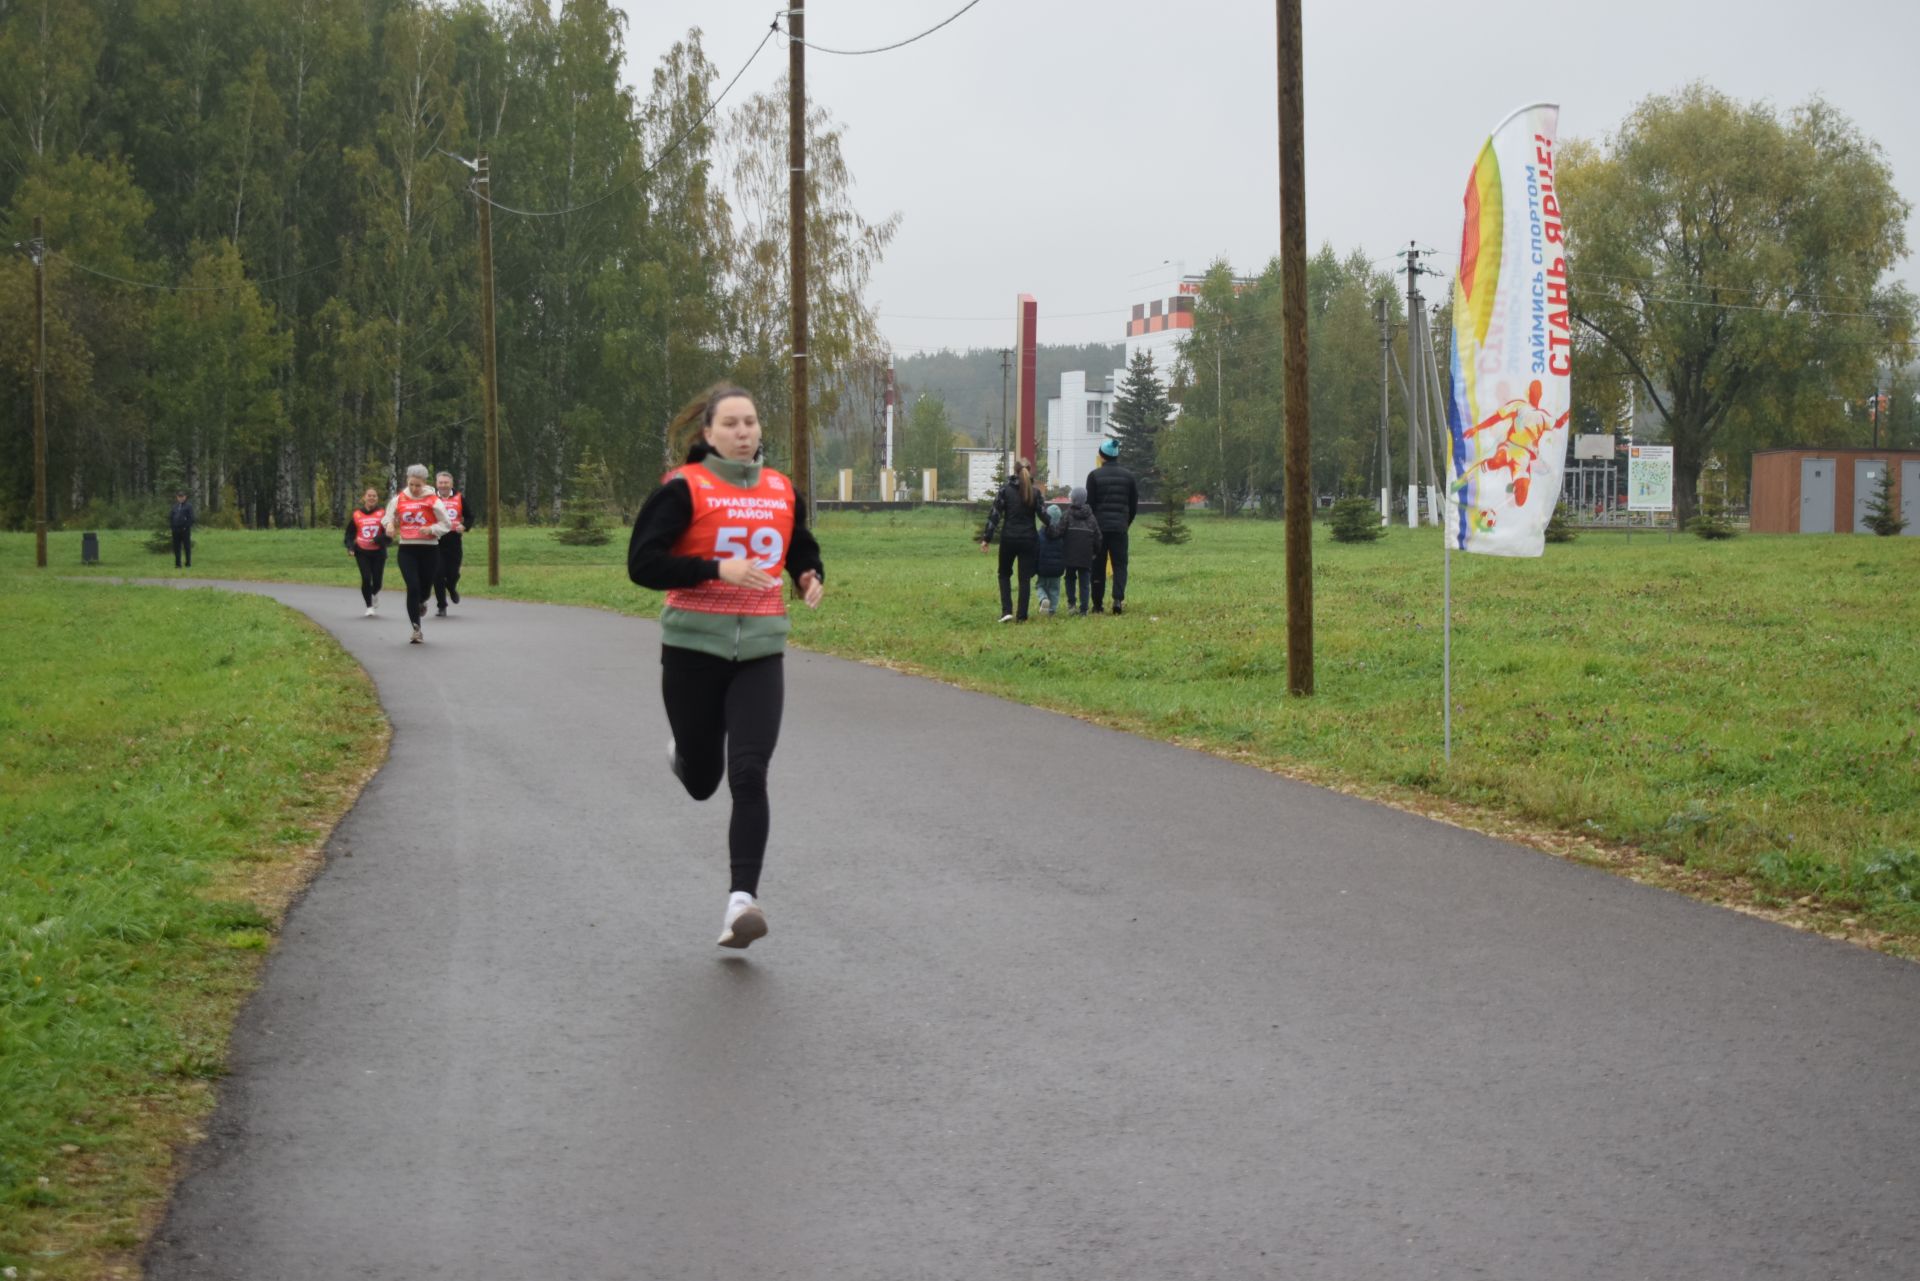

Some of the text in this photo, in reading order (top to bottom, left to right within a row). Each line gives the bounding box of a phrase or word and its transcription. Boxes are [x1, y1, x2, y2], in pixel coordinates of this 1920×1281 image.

[1525, 165, 1545, 374] ЗАЙМИСЬ СПОРТОМ
[1546, 257, 1572, 377] СТАНЬ
[706, 497, 788, 511] ТУКАЕВСКИЙ
[727, 507, 774, 520] РАЙОН
[712, 526, 784, 570] 59
